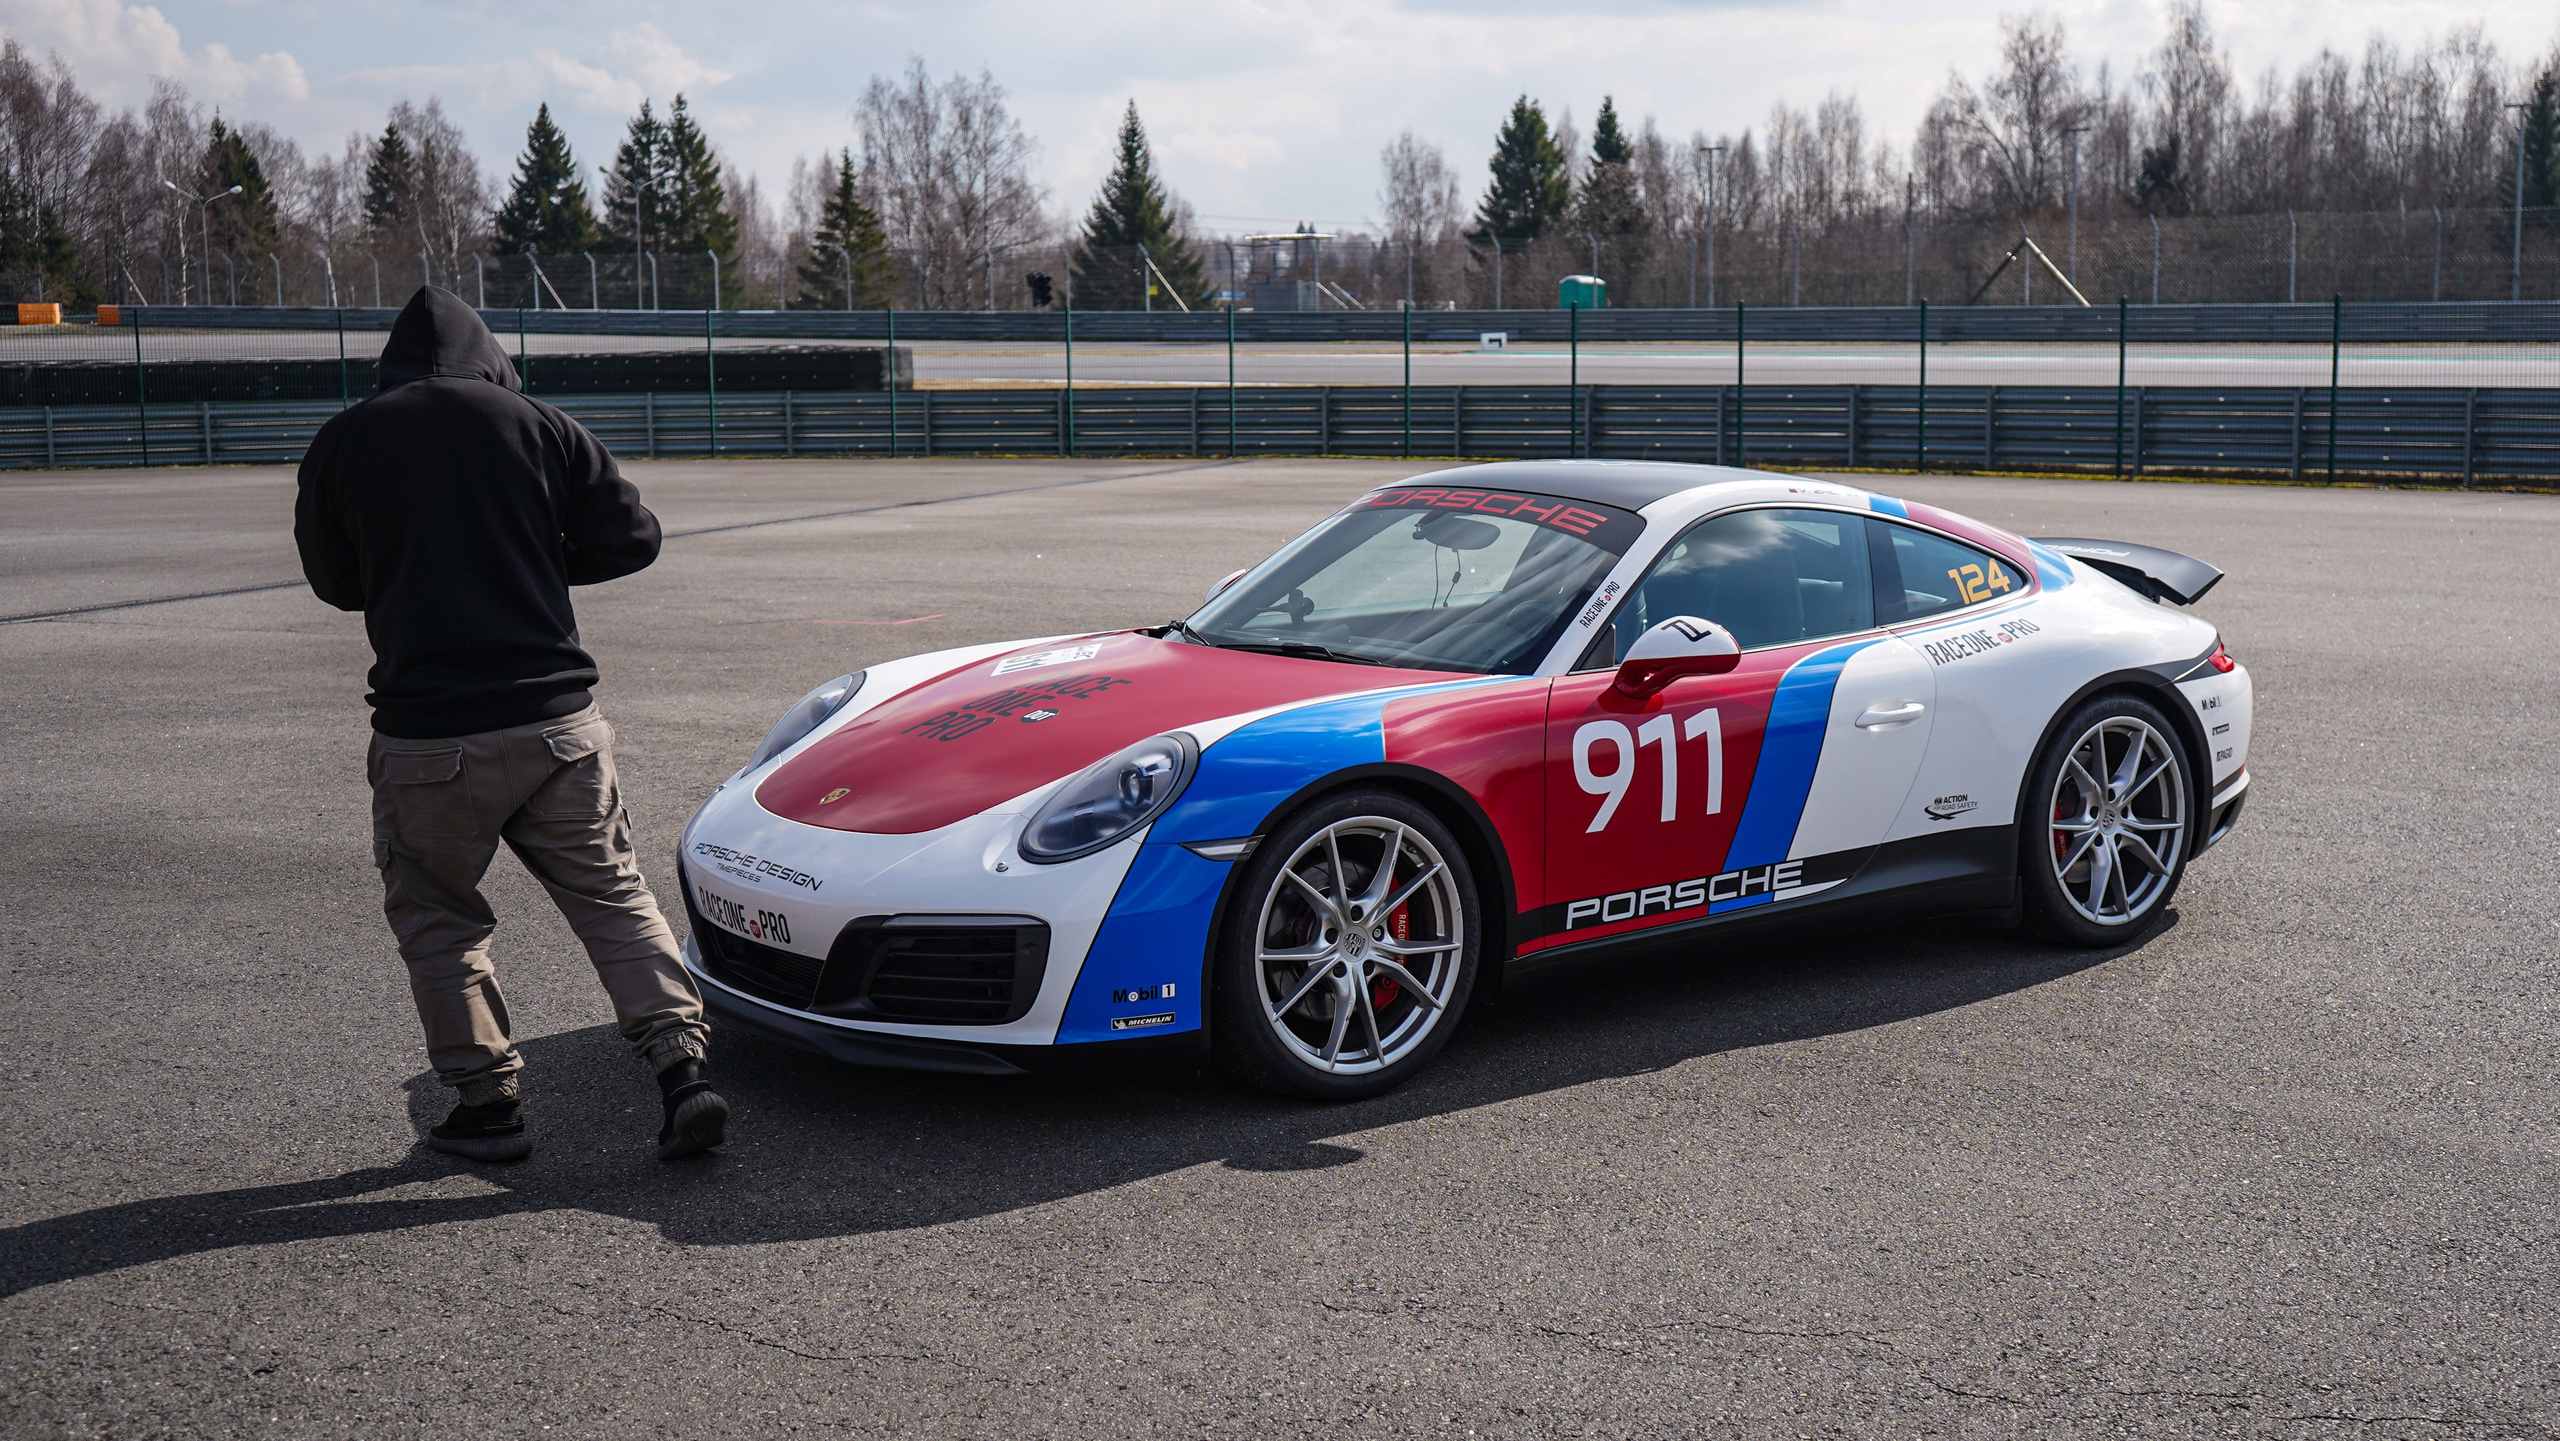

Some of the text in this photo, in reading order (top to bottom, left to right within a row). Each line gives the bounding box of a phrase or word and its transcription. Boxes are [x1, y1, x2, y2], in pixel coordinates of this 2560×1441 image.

[1345, 489, 1608, 535] PORSCHE
[2044, 545, 2131, 557] PORSC
[1604, 580, 1620, 597] PRO
[1946, 558, 2011, 605] 124
[2000, 618, 2041, 640] PRO
[1014, 670, 1135, 699] RACE
[961, 689, 1057, 717] ONE
[900, 710, 997, 743] PRO
[1572, 708, 1723, 833] 911
[1941, 803, 1956, 811] ROAD
[1956, 801, 1978, 810] SAFETY
[1943, 794, 1968, 804] ACTION
[692, 842, 824, 891] PORSCHE DESIGN
[716, 862, 762, 883] TIMEPIECES
[1565, 860, 1804, 930] PORSCHE
[757, 909, 791, 944] PRO
[1113, 985, 1158, 1004] Mobil
[1128, 1015, 1172, 1026] MICHELIN
